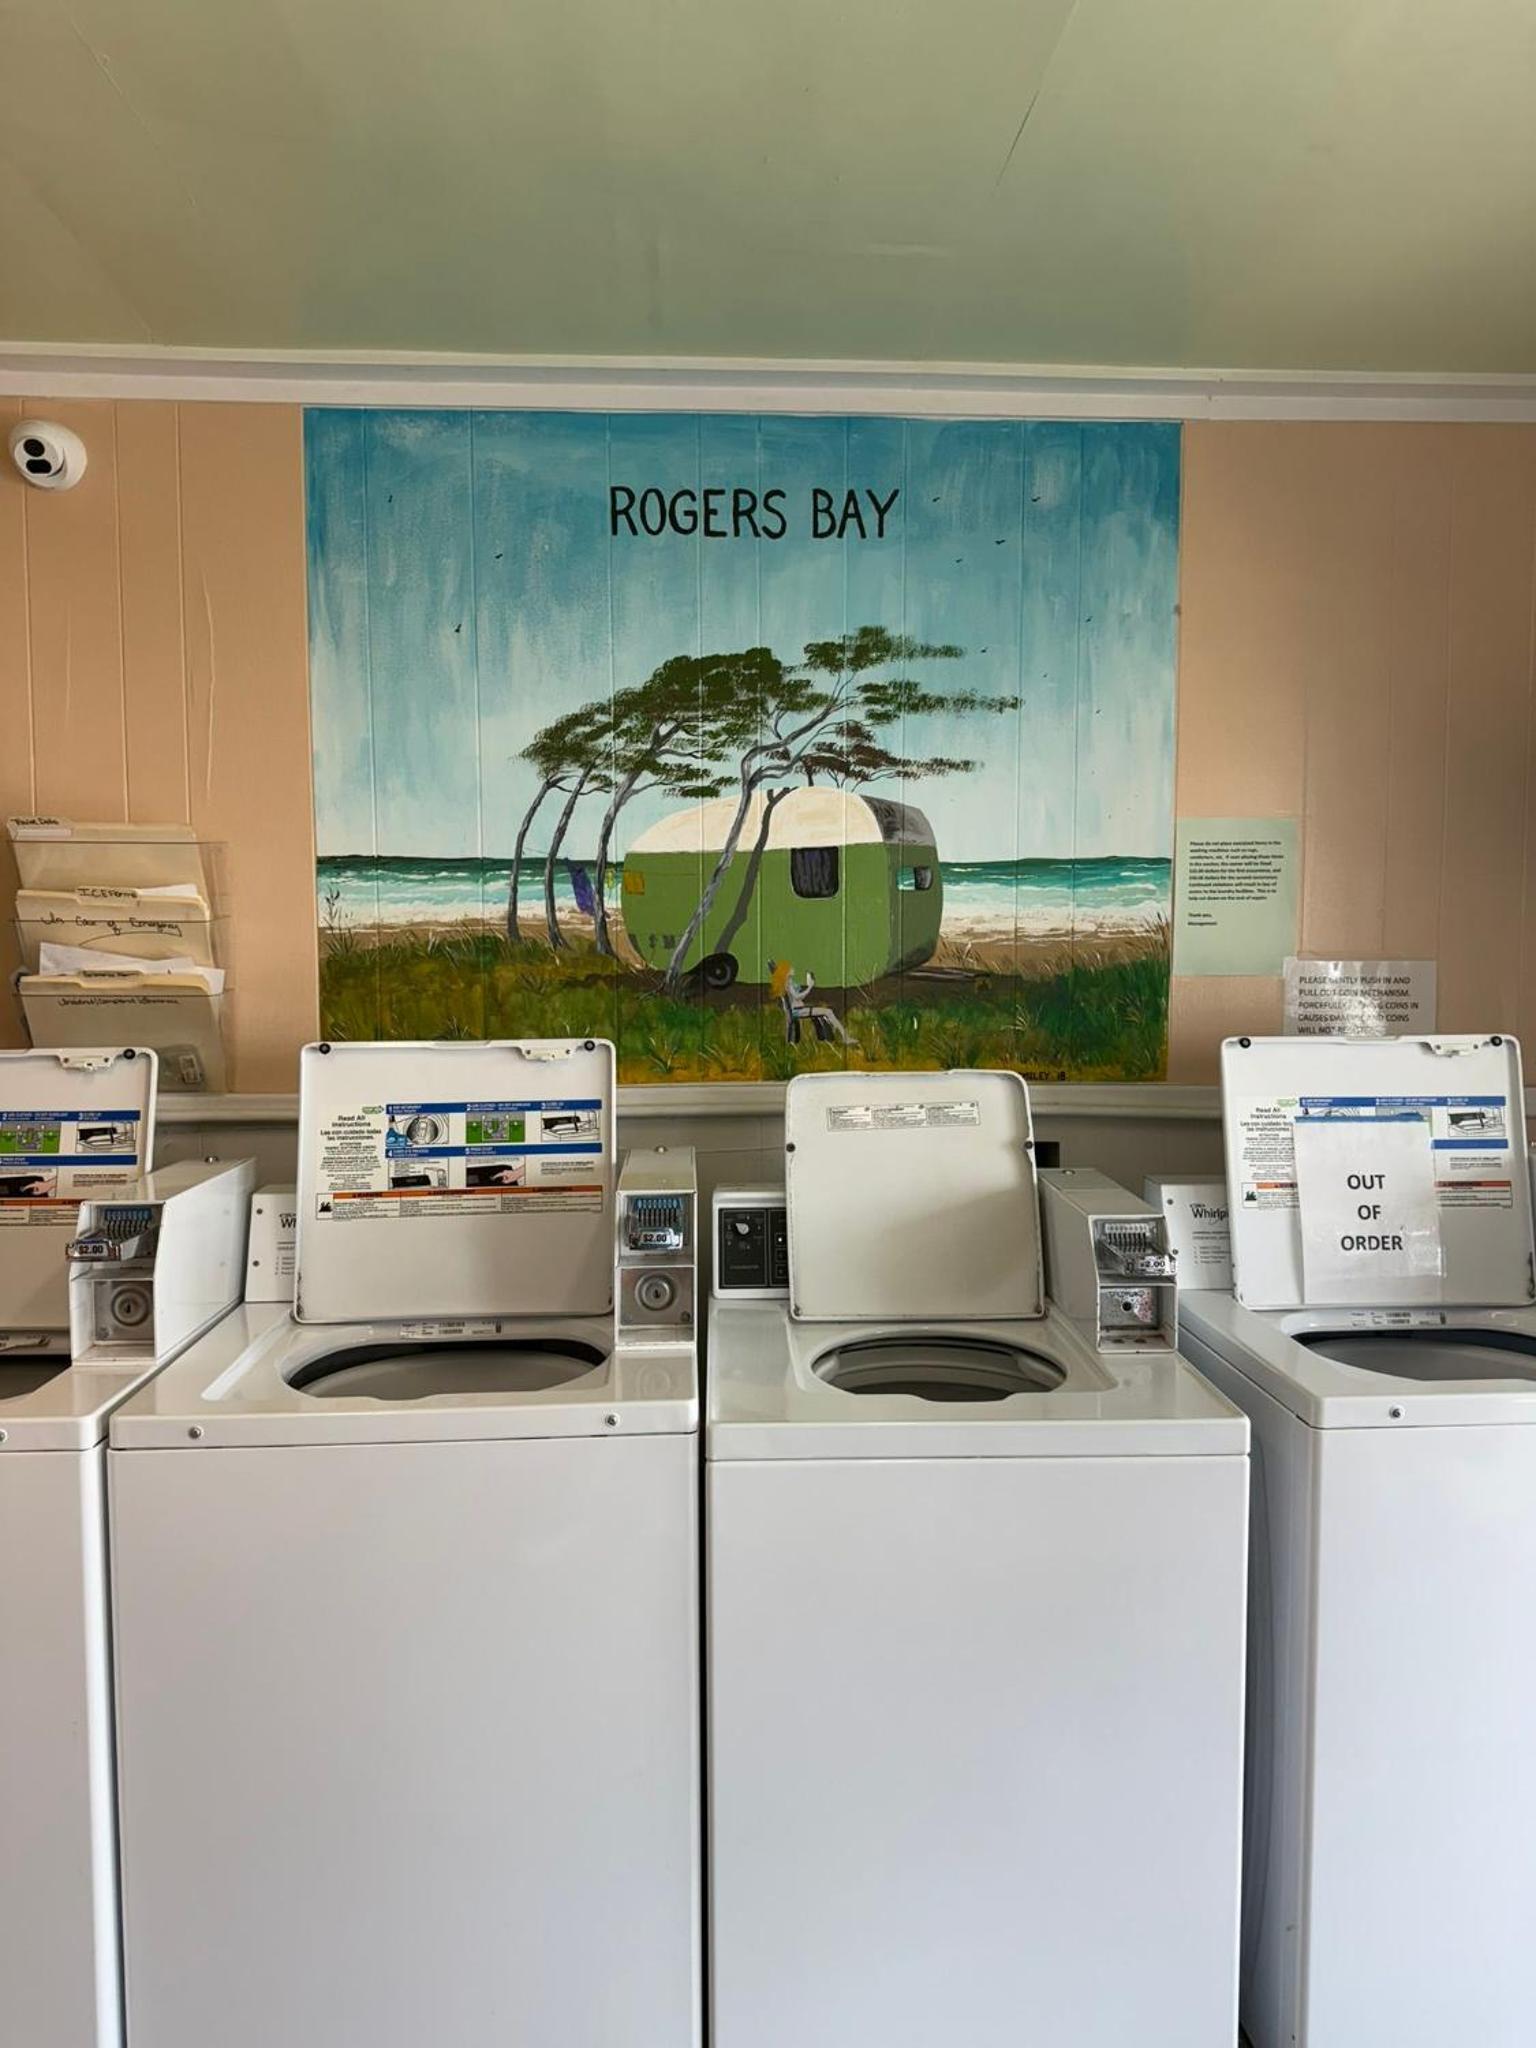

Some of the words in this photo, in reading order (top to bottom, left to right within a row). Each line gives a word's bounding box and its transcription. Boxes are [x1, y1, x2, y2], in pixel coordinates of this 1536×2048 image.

[610, 485, 787, 539] ROGERS
[812, 488, 900, 539] BAY
[1299, 976, 1327, 984] PLEASE
[1383, 976, 1391, 984] IN
[1393, 976, 1411, 984] AND
[1299, 989, 1317, 997] PULL
[1298, 1026, 1317, 1034] WILL
[1347, 1174, 1386, 1190] OUT
[1357, 1205, 1381, 1220] OF
[1341, 1235, 1403, 1251] ORDER
[79, 1245, 104, 1255] $2.00
